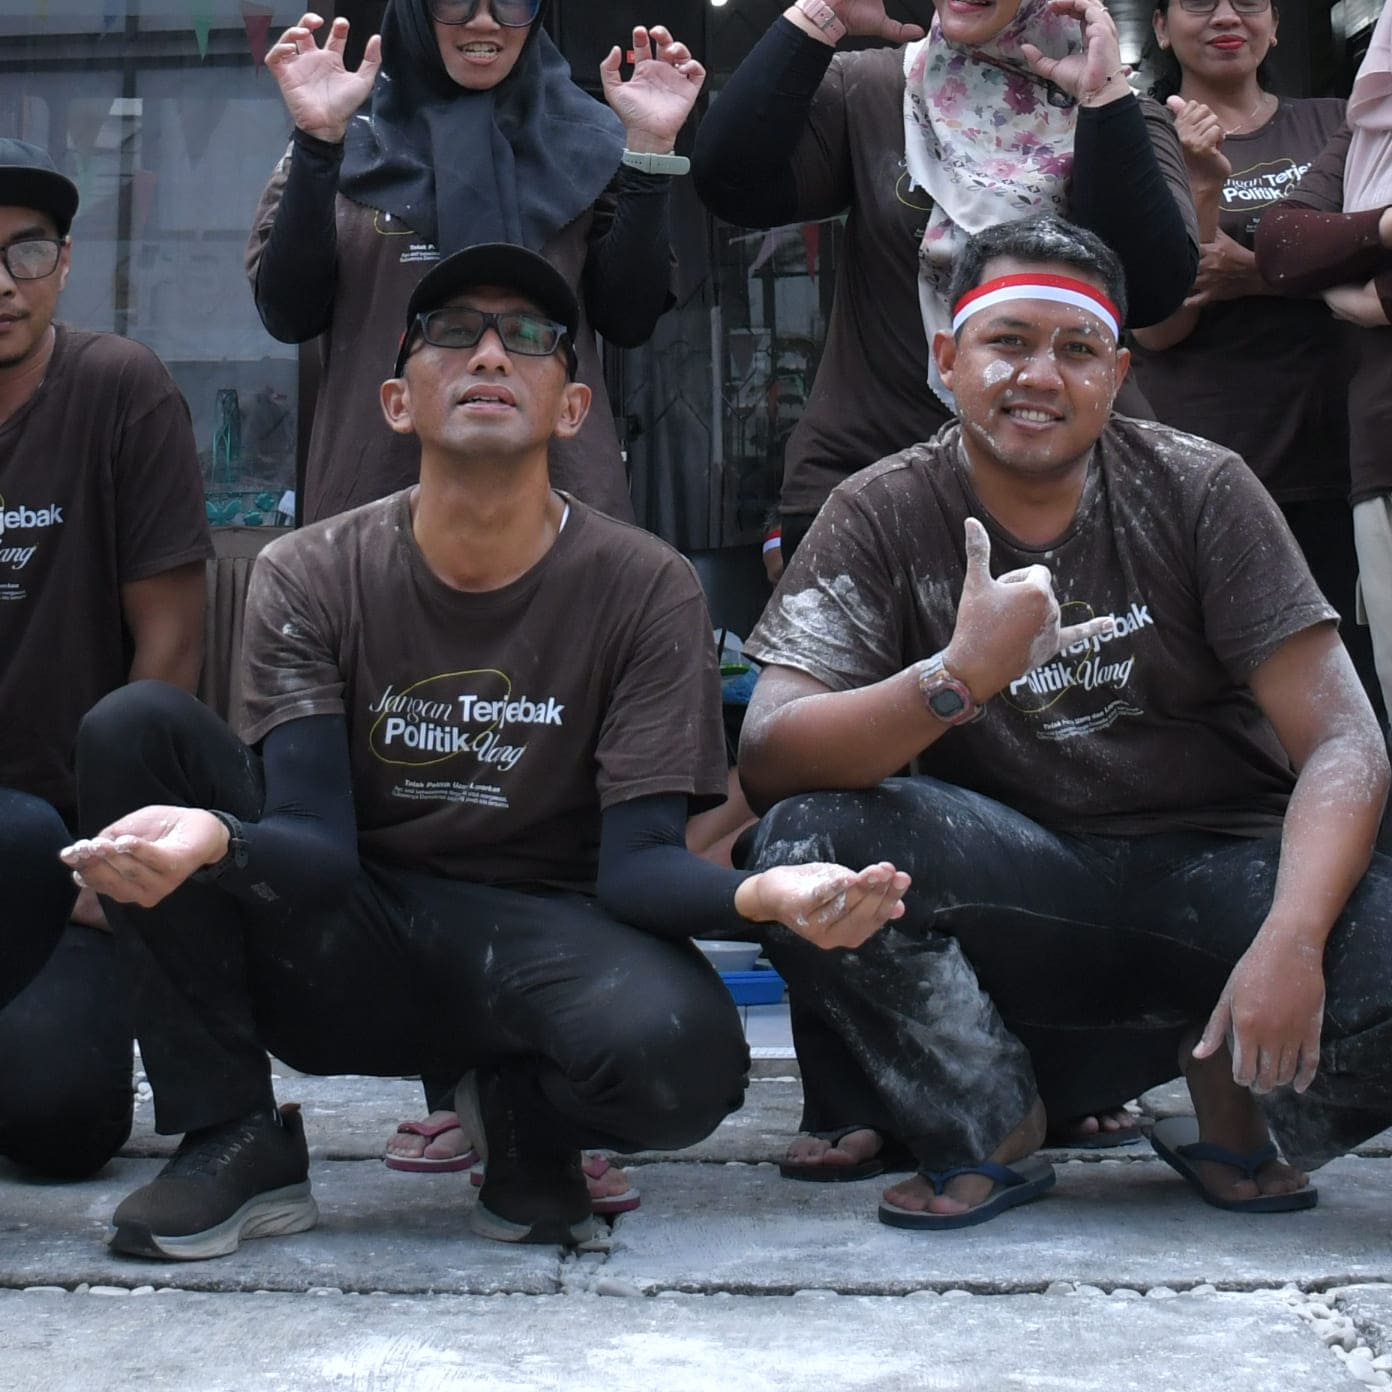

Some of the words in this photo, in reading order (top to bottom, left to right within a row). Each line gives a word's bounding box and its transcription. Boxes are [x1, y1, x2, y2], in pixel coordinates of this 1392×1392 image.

[1222, 186, 1285, 203] Politik
[1076, 655, 1135, 691] Uang
[369, 684, 453, 724] Jangan
[458, 694, 565, 729] Terjebak
[384, 717, 472, 753] Politik
[471, 730, 527, 772] Uang
